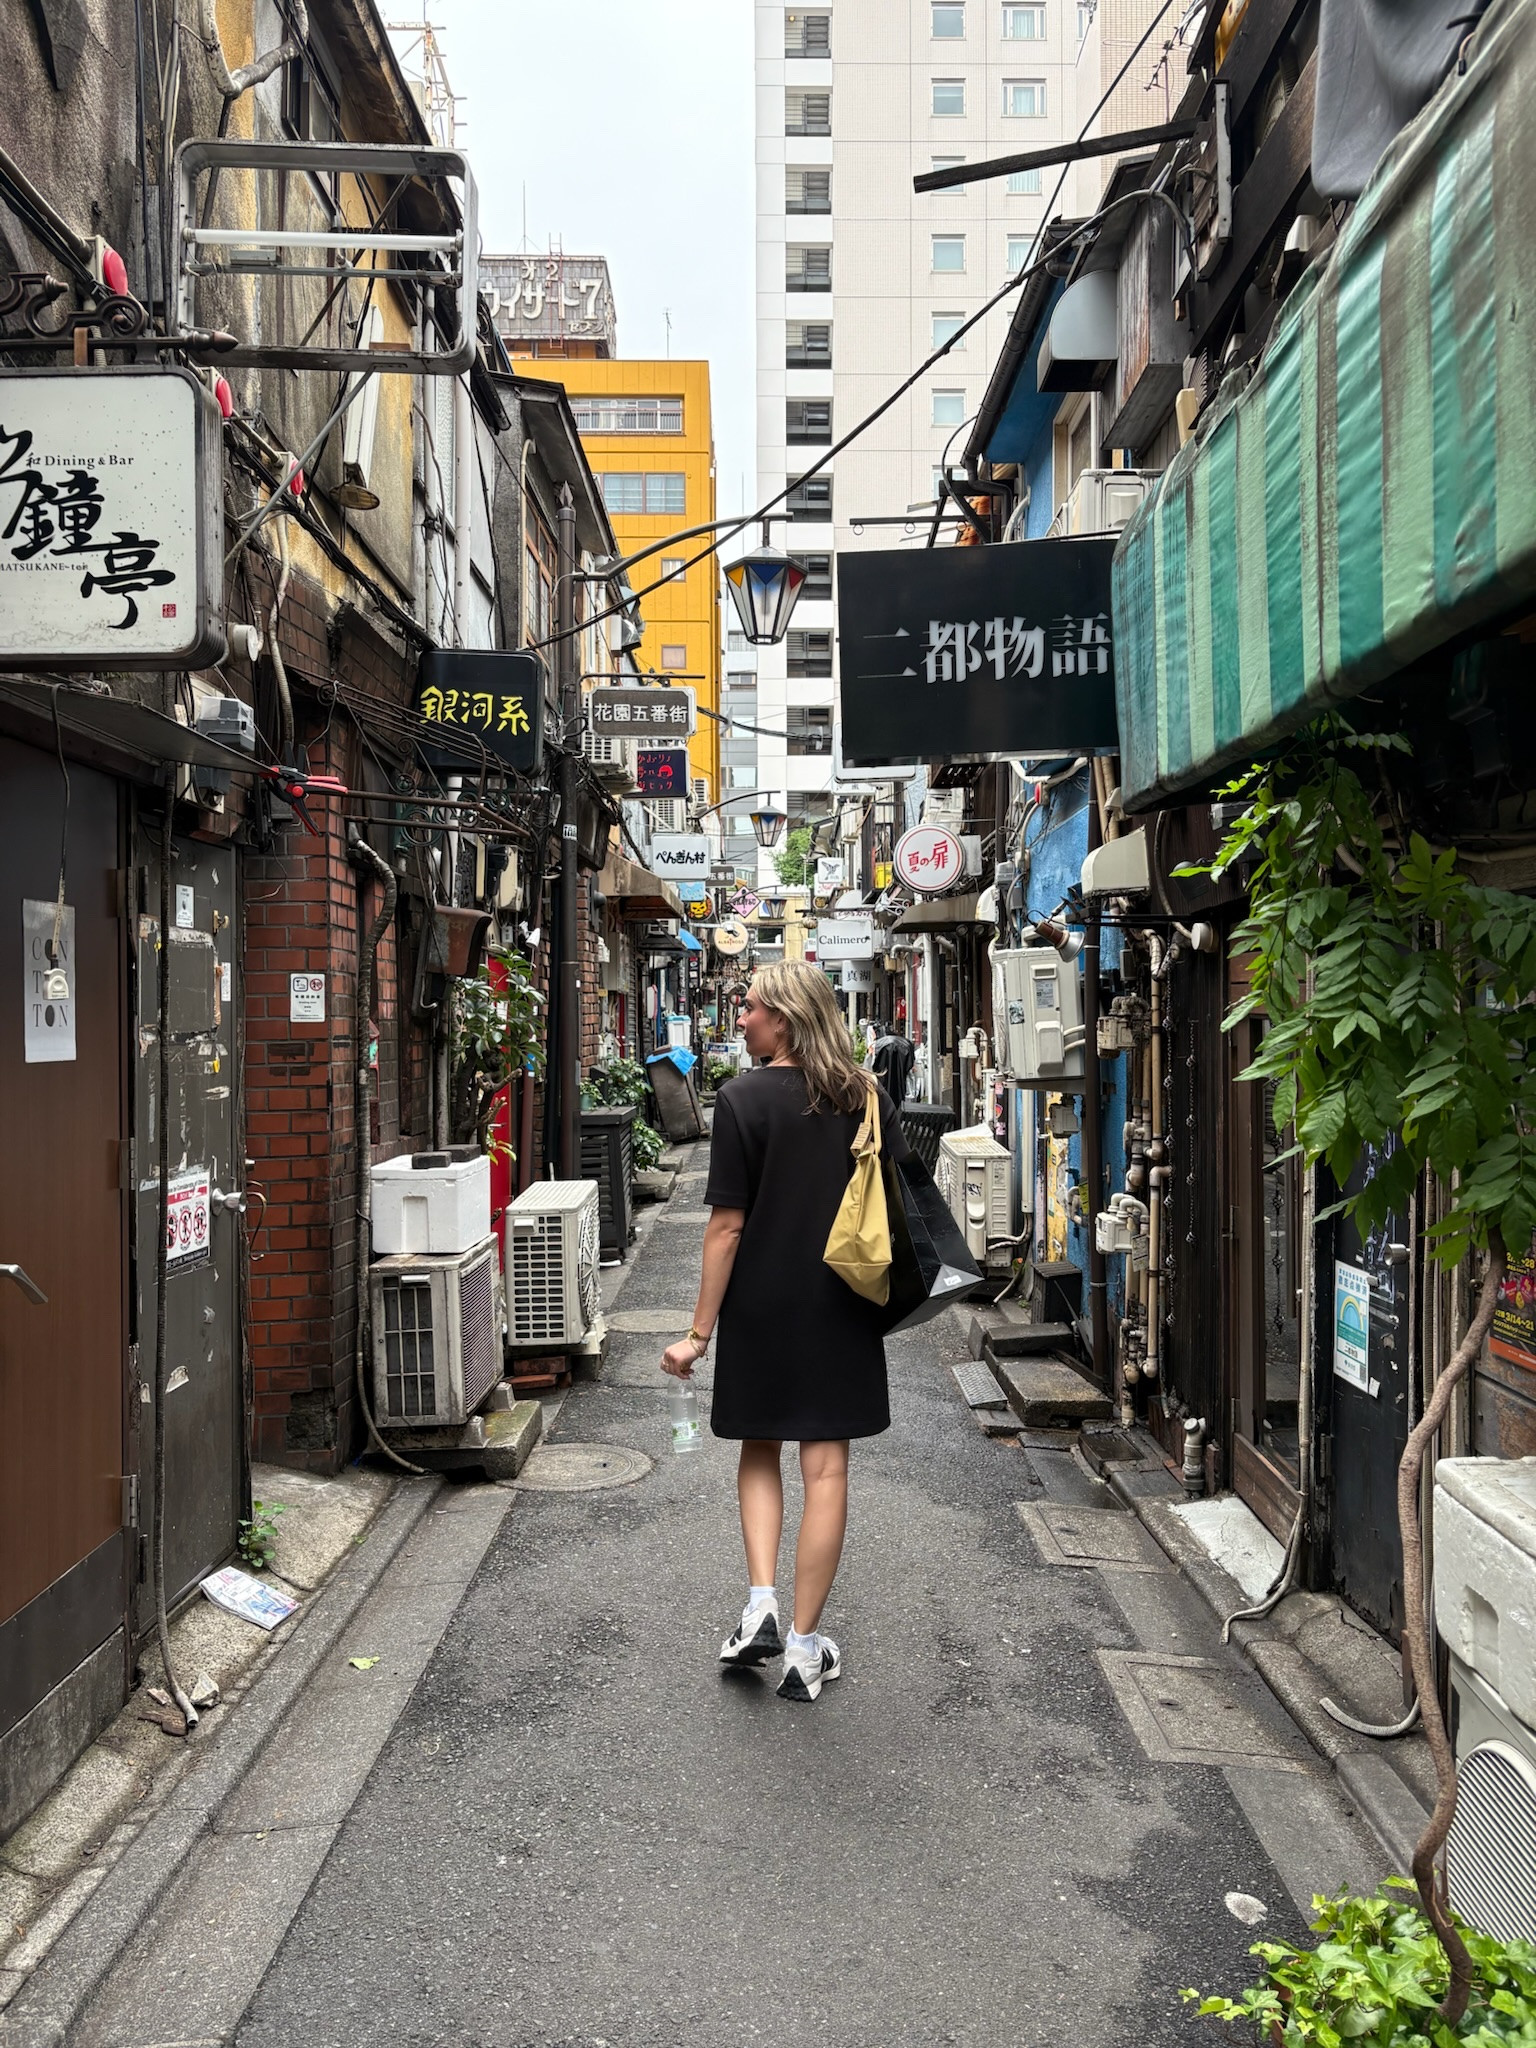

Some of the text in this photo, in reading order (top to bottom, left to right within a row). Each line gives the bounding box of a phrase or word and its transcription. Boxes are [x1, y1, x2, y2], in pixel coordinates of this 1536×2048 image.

[44, 454, 95, 470] Dining
[97, 456, 106, 466] &
[108, 454, 135, 466] Bar
[857, 612, 1113, 684] 二都物語
[418, 685, 531, 736] 銀河系
[594, 703, 688, 723] 花園五番街
[655, 849, 706, 864] ぺんぎん村
[907, 839, 949, 874] 夏の扉
[818, 935, 867, 945] Calimero
[32, 1003, 69, 1028] TON
